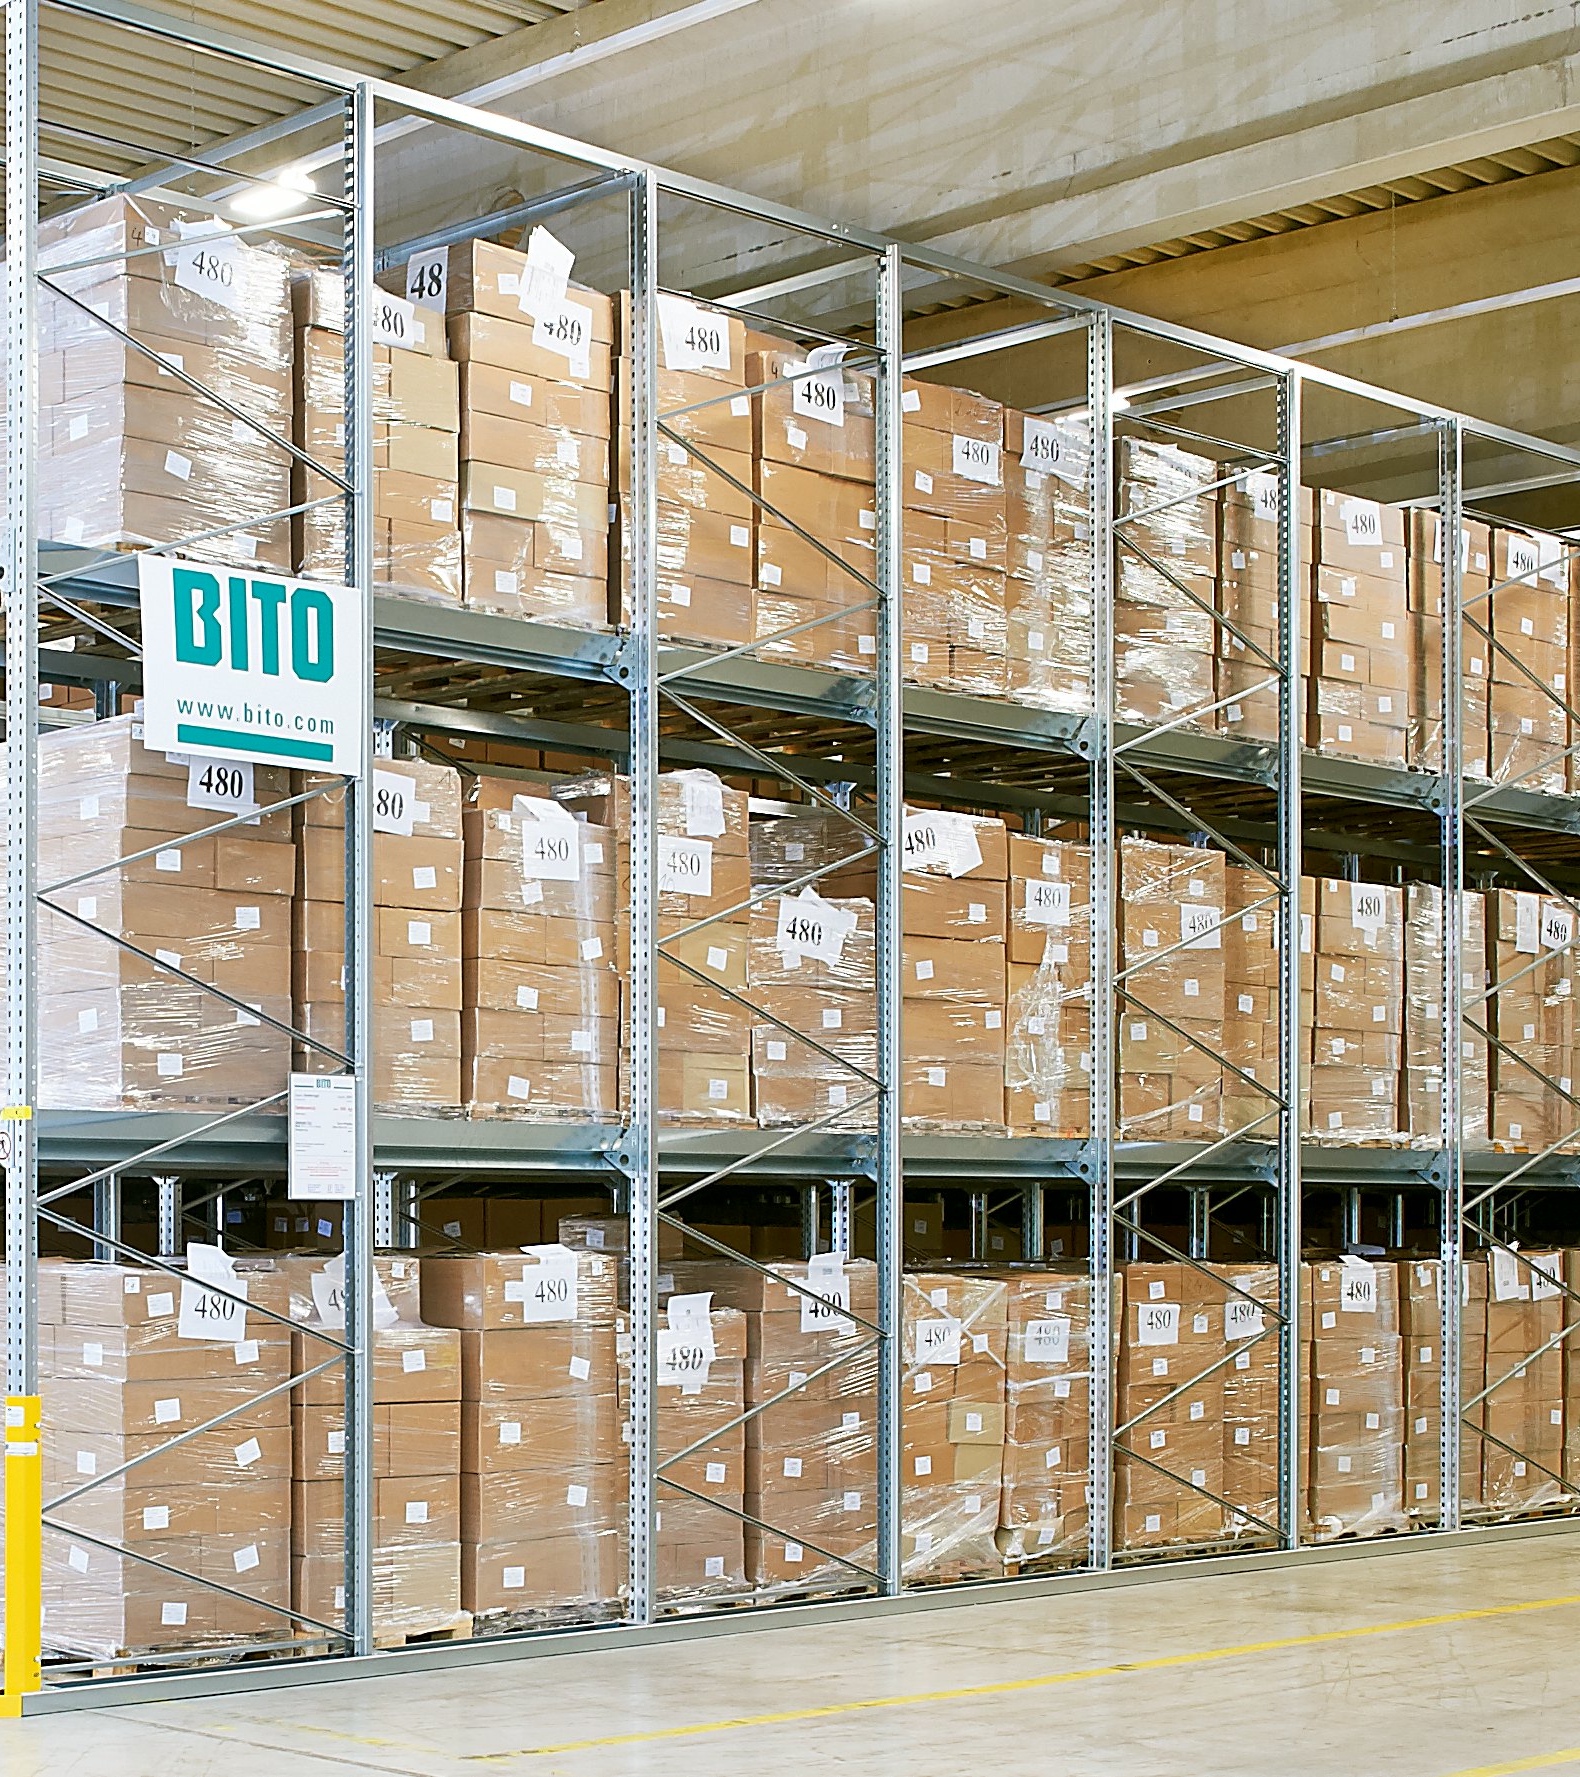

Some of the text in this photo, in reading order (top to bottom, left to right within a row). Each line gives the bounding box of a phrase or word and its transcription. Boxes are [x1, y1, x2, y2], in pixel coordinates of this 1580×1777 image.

[192, 250, 233, 287] 480
[410, 262, 443, 299] 48
[373, 304, 405, 339] 80
[684, 326, 720, 355] 480
[801, 380, 836, 411] 480
[961, 440, 989, 466] 480
[1029, 434, 1060, 463] 480
[1260, 489, 1278, 512] 48
[1351, 513, 1376, 535] 480
[1512, 550, 1534, 572] 480
[172, 567, 334, 683] BITO
[176, 699, 334, 735] www.bito.com
[199, 764, 244, 799] 480
[373, 789, 404, 820] 80
[534, 836, 570, 862] 480
[904, 826, 937, 855] 480
[666, 851, 701, 877] 480
[1033, 886, 1061, 908] 480
[1357, 896, 1381, 917] 480
[785, 916, 823, 946] 480
[1188, 913, 1214, 933] 480
[1546, 918, 1567, 943] 480
[534, 1277, 568, 1303] 480
[1346, 1280, 1371, 1302] 480
[194, 1292, 235, 1321] 480
[808, 1291, 843, 1319] 480
[1230, 1303, 1256, 1324] 480
[1146, 1309, 1172, 1330] 480
[924, 1325, 952, 1348] 480
[665, 1346, 704, 1372] 480
